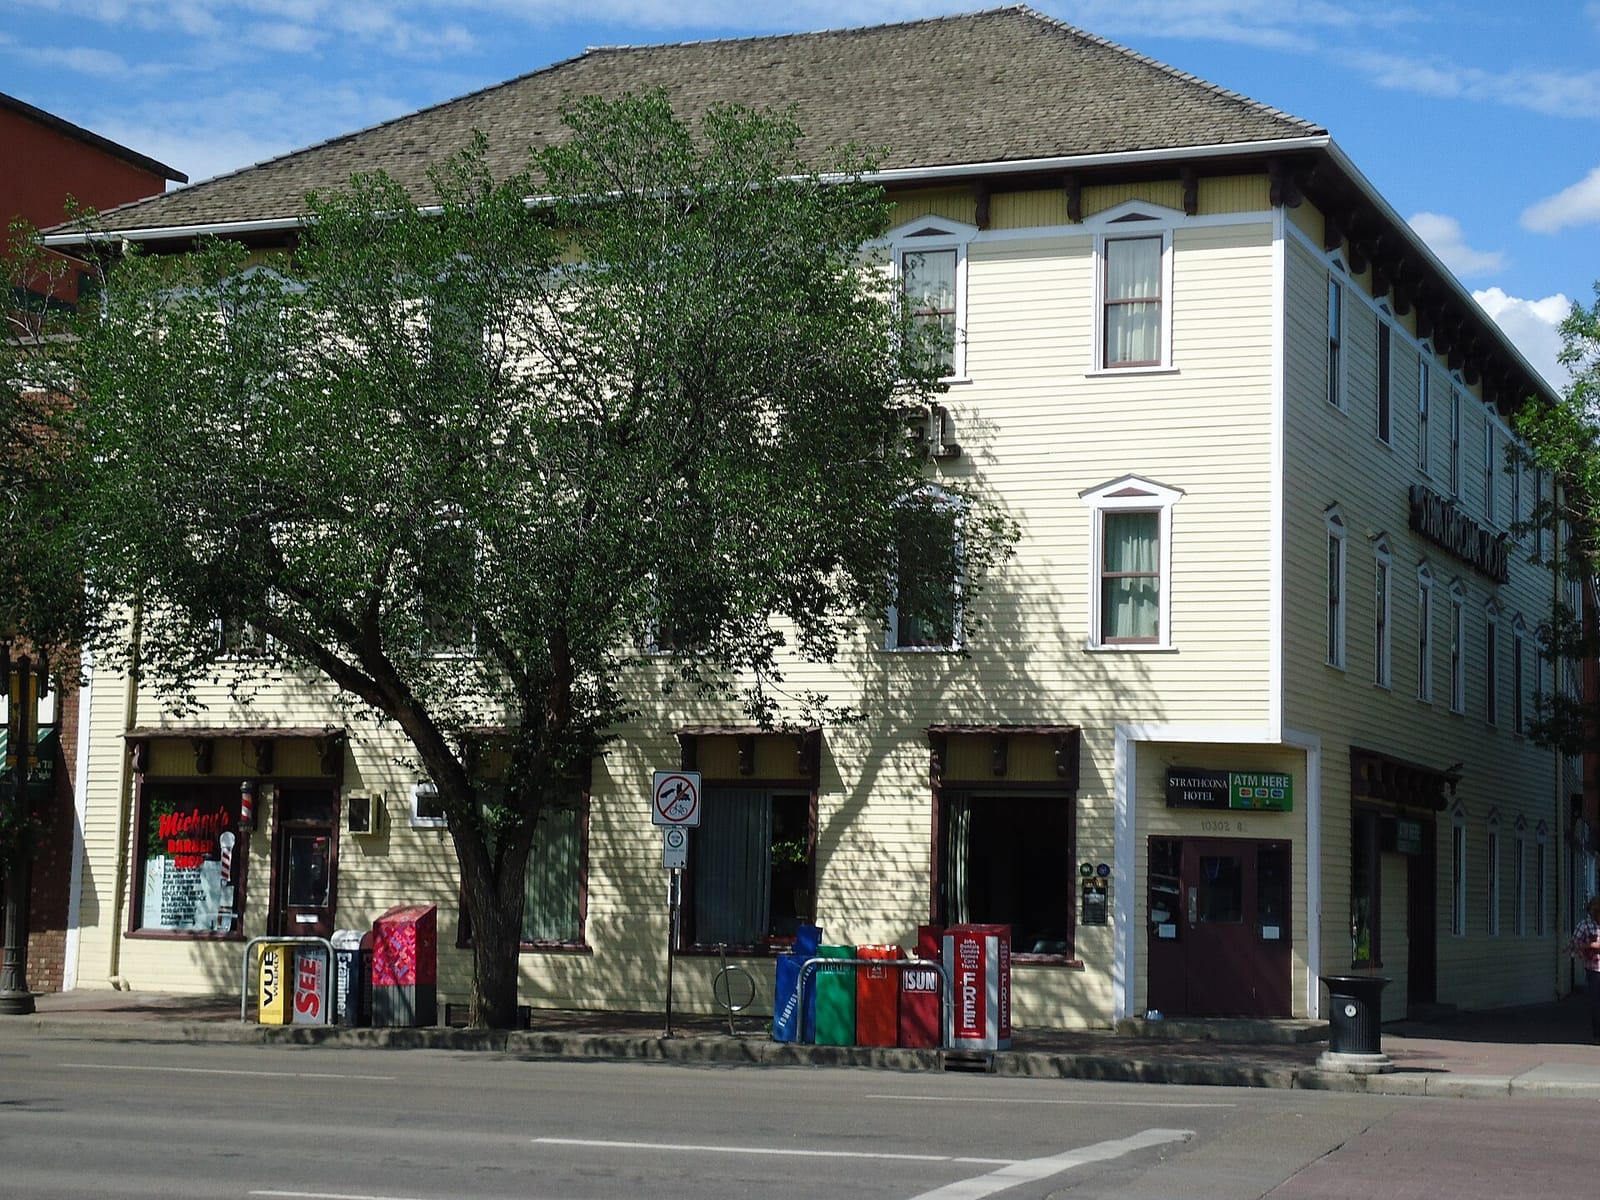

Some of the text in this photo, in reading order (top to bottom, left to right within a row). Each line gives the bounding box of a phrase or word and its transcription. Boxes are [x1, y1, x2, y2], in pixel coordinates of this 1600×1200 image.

[1169, 777, 1228, 789] STRATHCONA
[1234, 775, 1289, 788] ATM HERE
[1183, 790, 1215, 801] HOTEL
[1200, 821, 1230, 832] 10302
[167, 839, 214, 853] BARBER
[263, 952, 274, 1007] VUE
[336, 952, 352, 1018] Examiner
[908, 971, 935, 990] SUN
[294, 958, 321, 1019] SEE
[963, 972, 976, 1028] FREE
